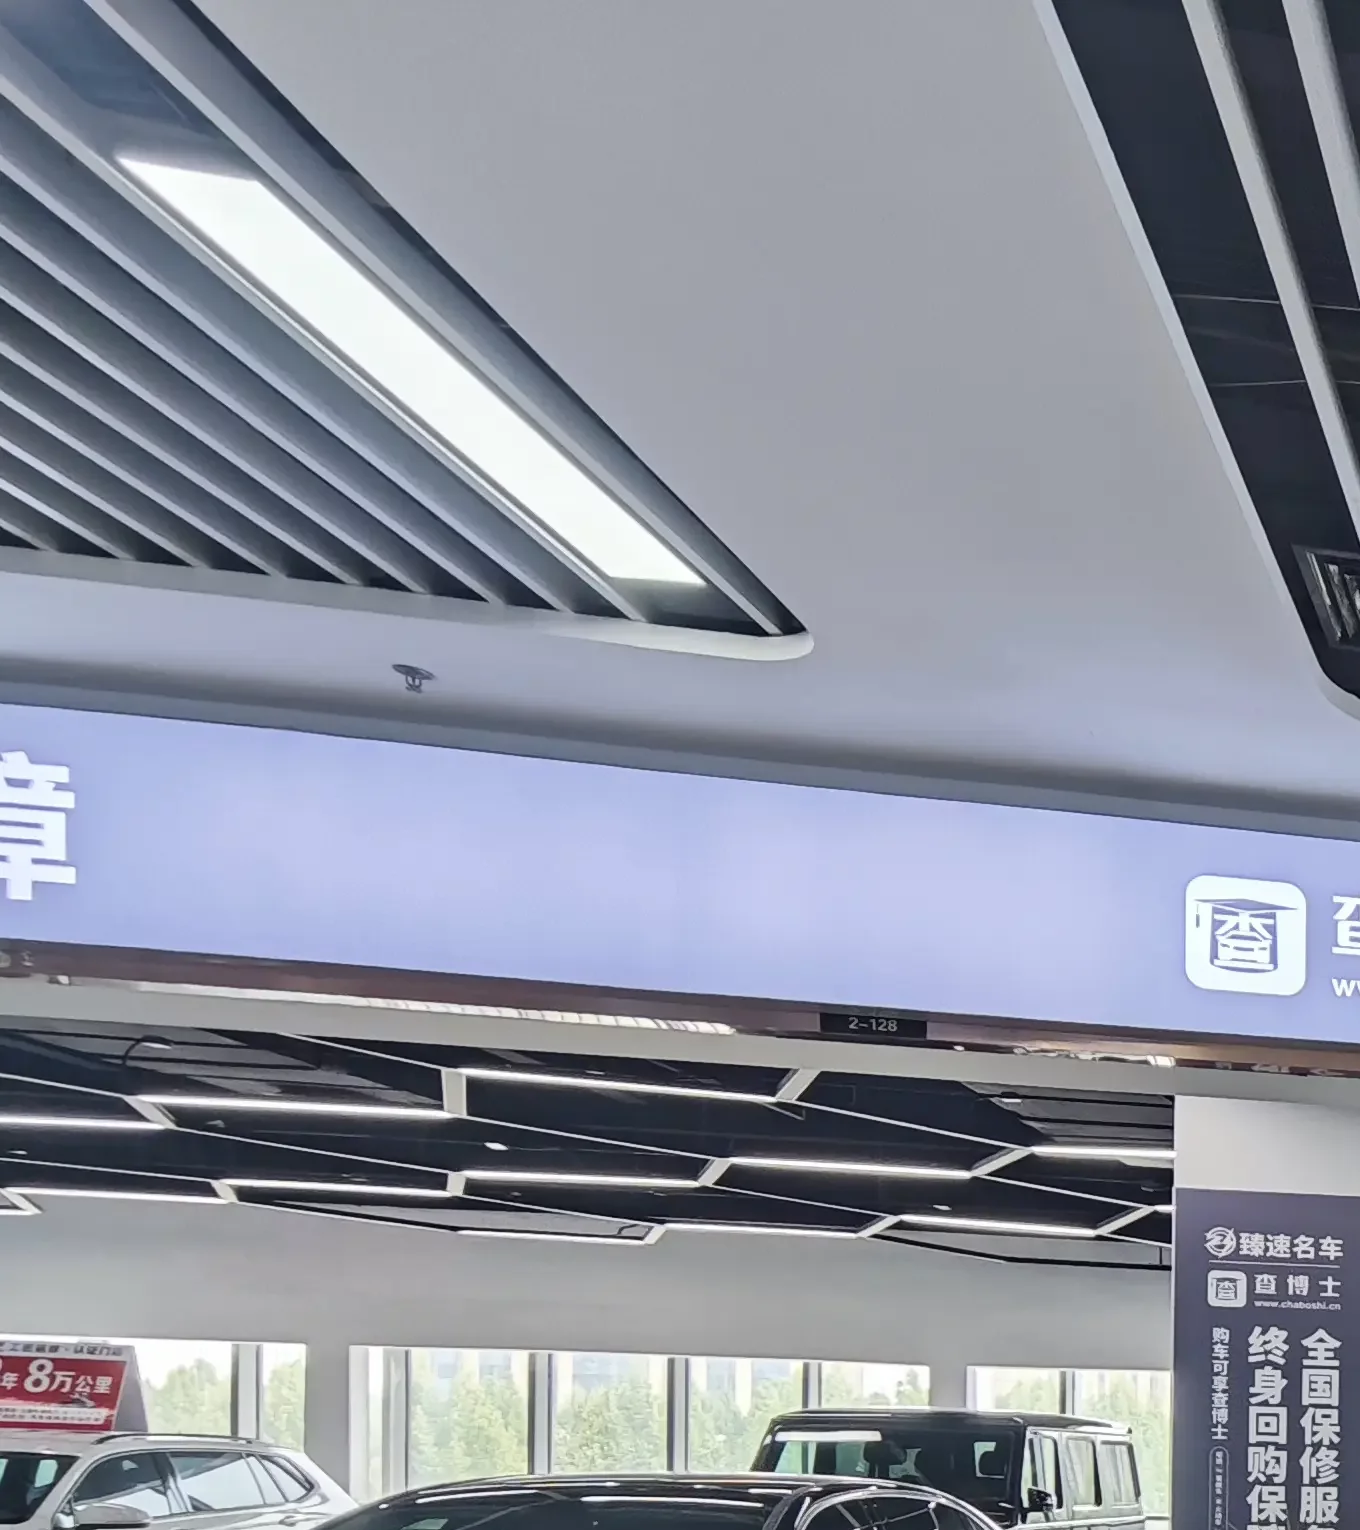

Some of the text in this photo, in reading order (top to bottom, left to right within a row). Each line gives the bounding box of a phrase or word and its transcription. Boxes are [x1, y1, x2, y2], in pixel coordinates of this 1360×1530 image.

[848, 1016, 898, 1032] 2-128
[1239, 1231, 1344, 1260] 臻速名车
[1253, 1273, 1342, 1298] 查博士
[0, 1358, 114, 1394] 年8万公里
[1210, 1327, 1231, 1441] 购车可享查博士
